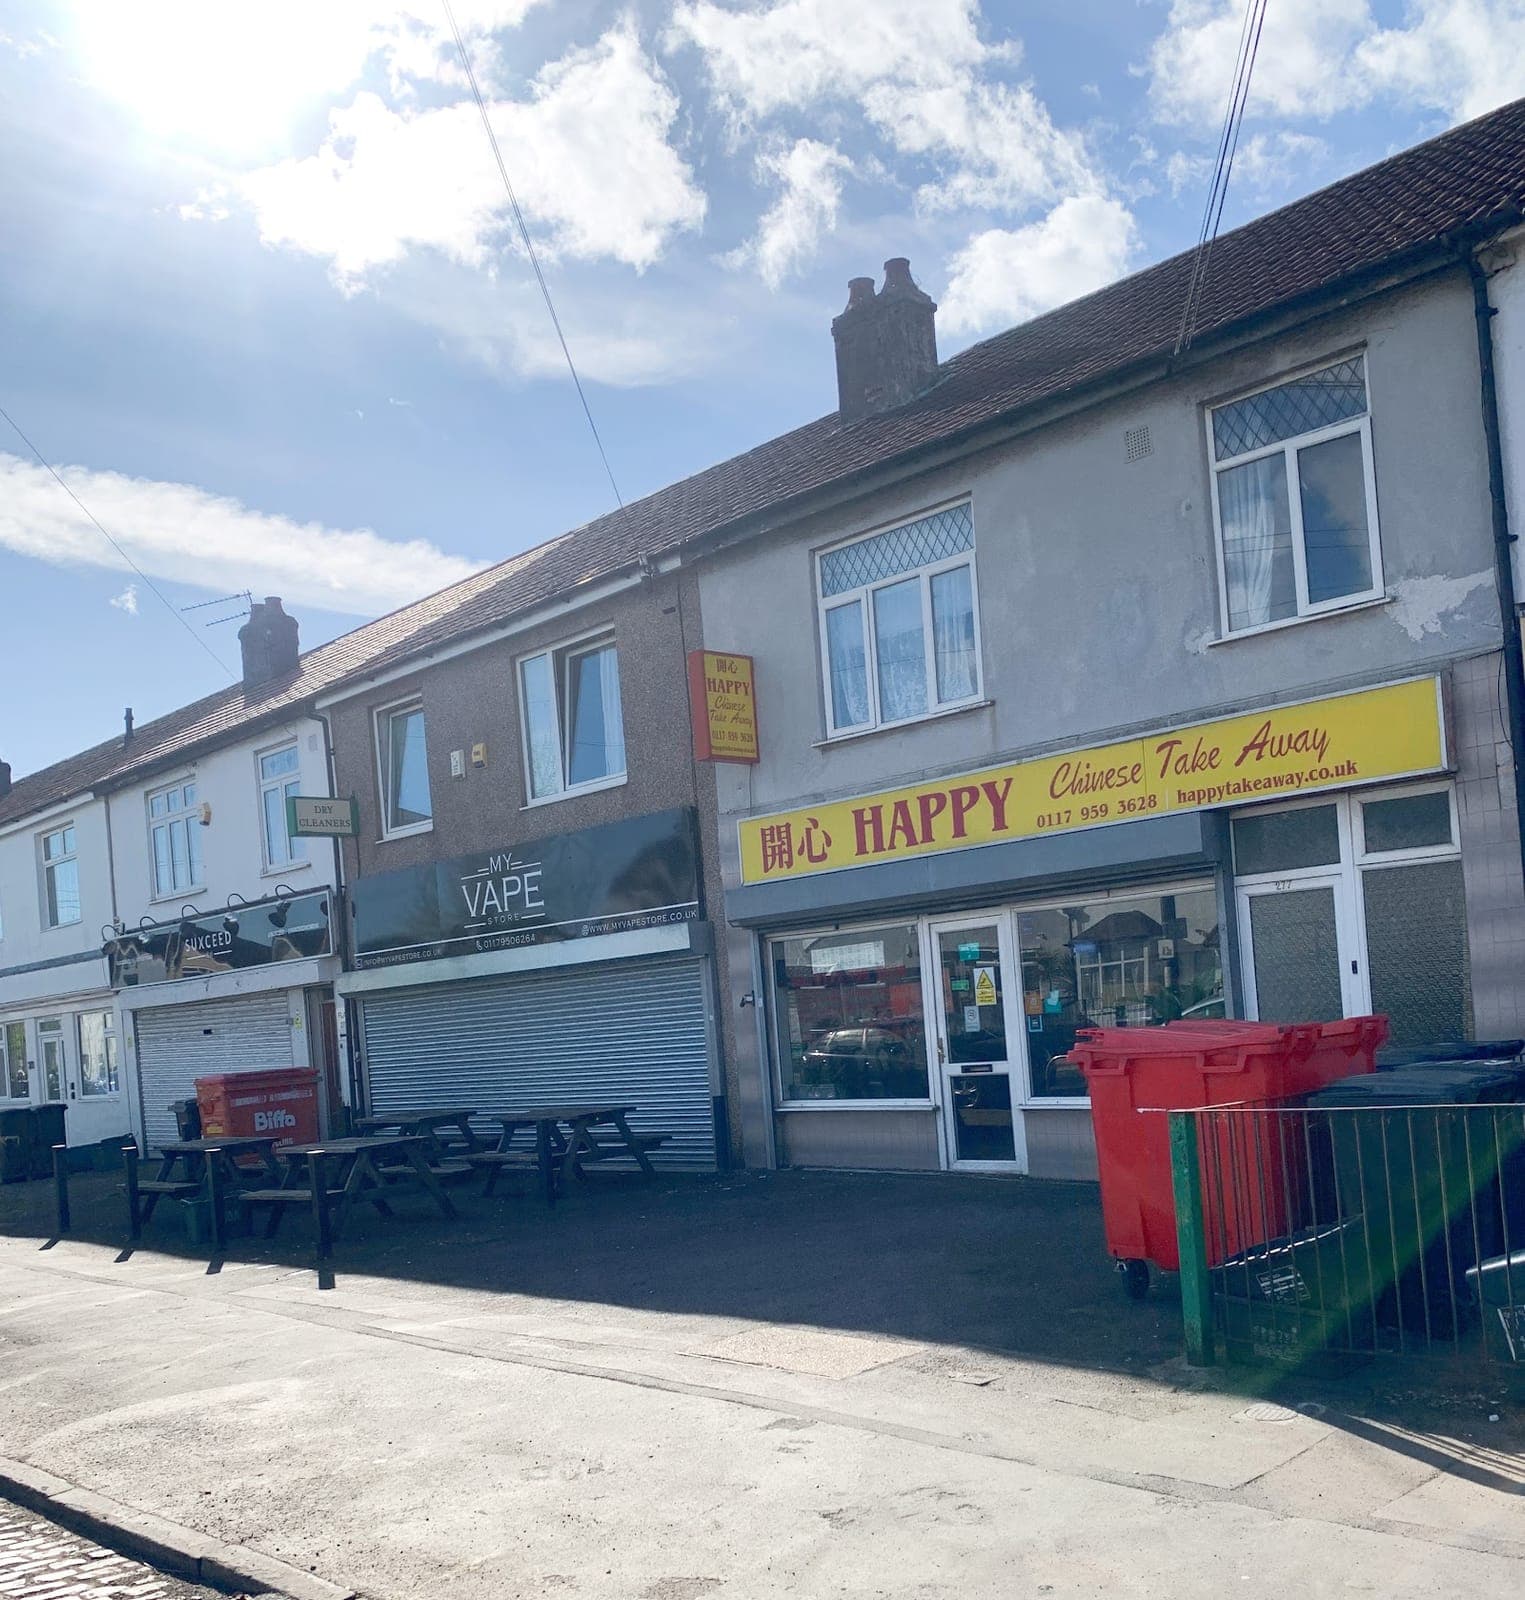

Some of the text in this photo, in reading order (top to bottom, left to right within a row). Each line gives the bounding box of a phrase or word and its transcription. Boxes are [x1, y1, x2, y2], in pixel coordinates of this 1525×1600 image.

[706, 678, 751, 696] HAPPY
[714, 696, 746, 712] Chinese
[709, 709, 753, 728] Take Away
[1049, 720, 1331, 800] Chinese Take Away
[1037, 759, 1359, 829] 0117 959 3628 happytakeaway.co.uk
[313, 805, 333, 814] DRY
[851, 777, 1014, 856] HAPPY
[299, 818, 351, 828] CLEANERS
[760, 818, 832, 873] 開心
[489, 852, 512, 874] MY
[461, 870, 545, 918] VAPE
[487, 912, 520, 925] STORE
[184, 930, 232, 952] SUXCEED
[484, 933, 536, 949] 01179506264
[254, 1109, 296, 1132] Biffa
